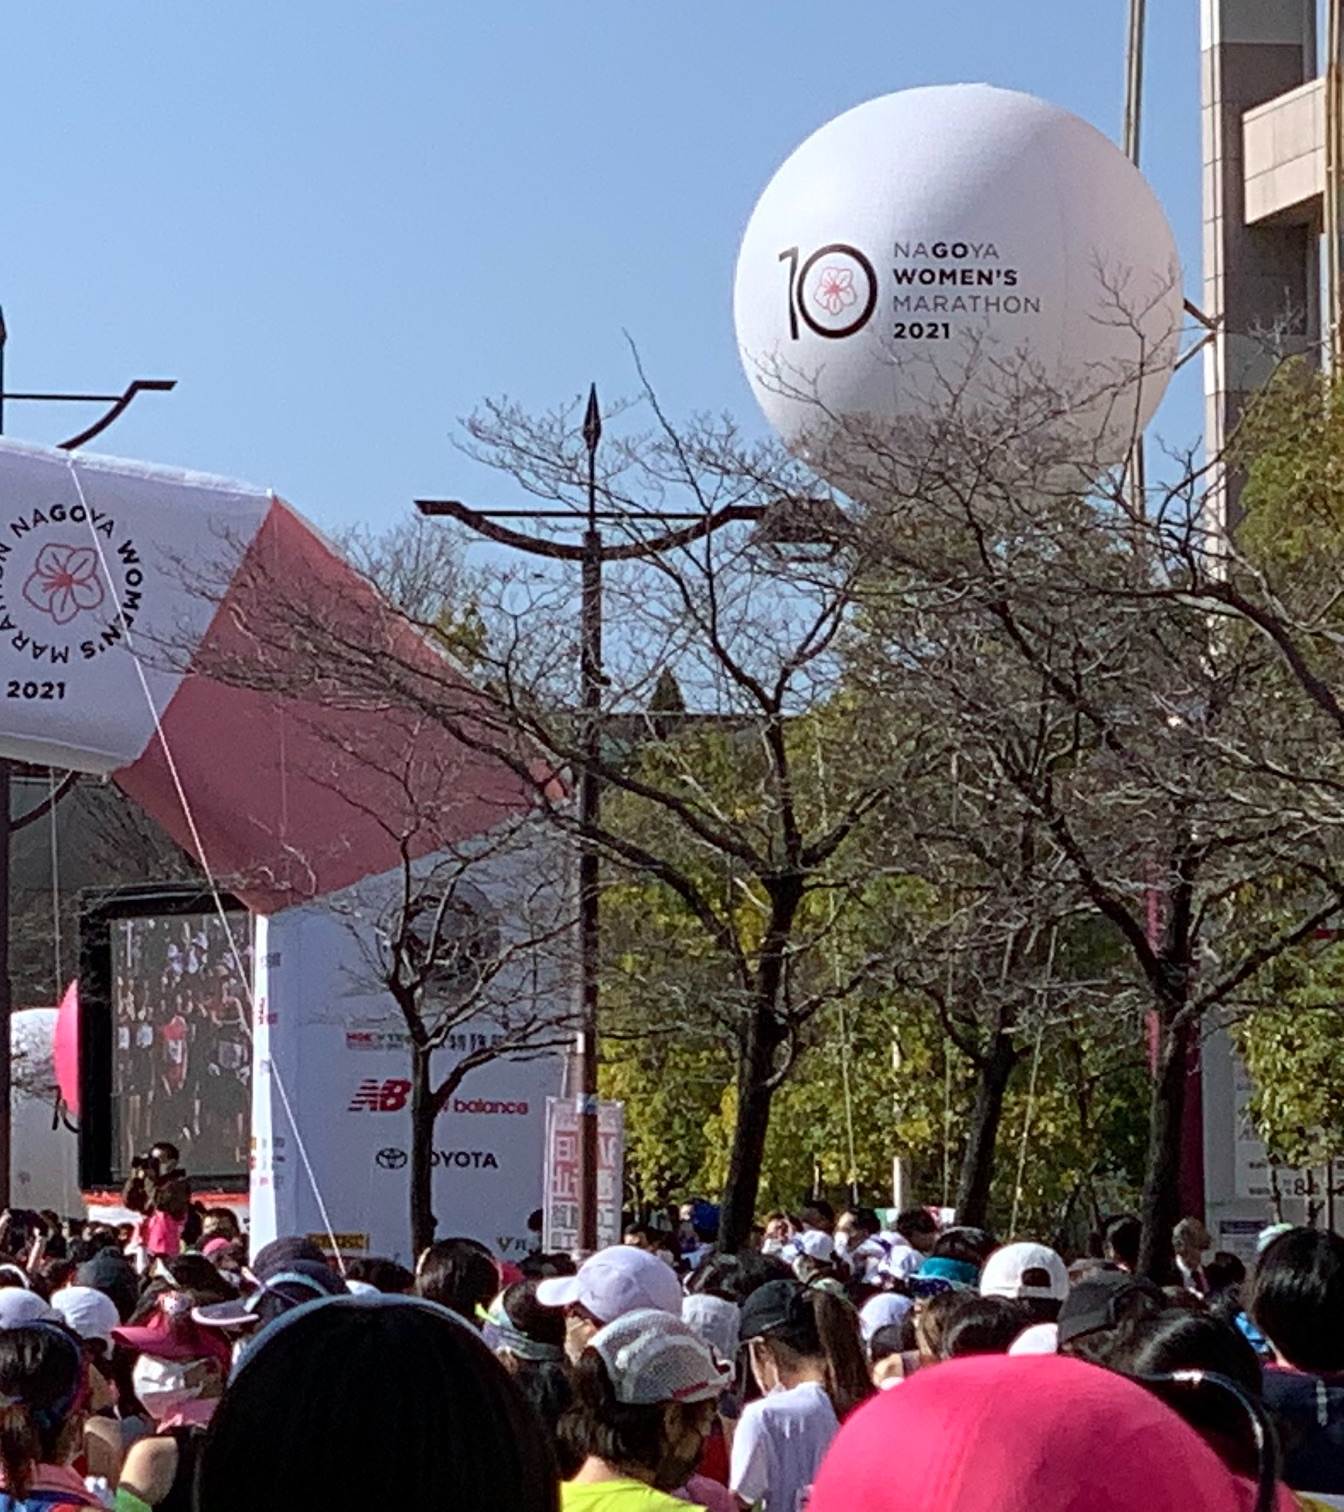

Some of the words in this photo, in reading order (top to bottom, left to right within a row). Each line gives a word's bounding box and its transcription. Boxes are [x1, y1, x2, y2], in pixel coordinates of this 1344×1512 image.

[893, 241, 1000, 260] NAGOYA
[893, 268, 1018, 286] WOMEN'S
[777, 243, 878, 340] 10
[893, 294, 1041, 315] MARATHON
[893, 322, 950, 340] 2021
[10, 504, 115, 539] NAGOYA
[80, 539, 144, 659] WOMEN'S
[7, 680, 65, 700] 2021
[454, 1098, 529, 1115] balance
[430, 1151, 499, 1169] OYOTA
